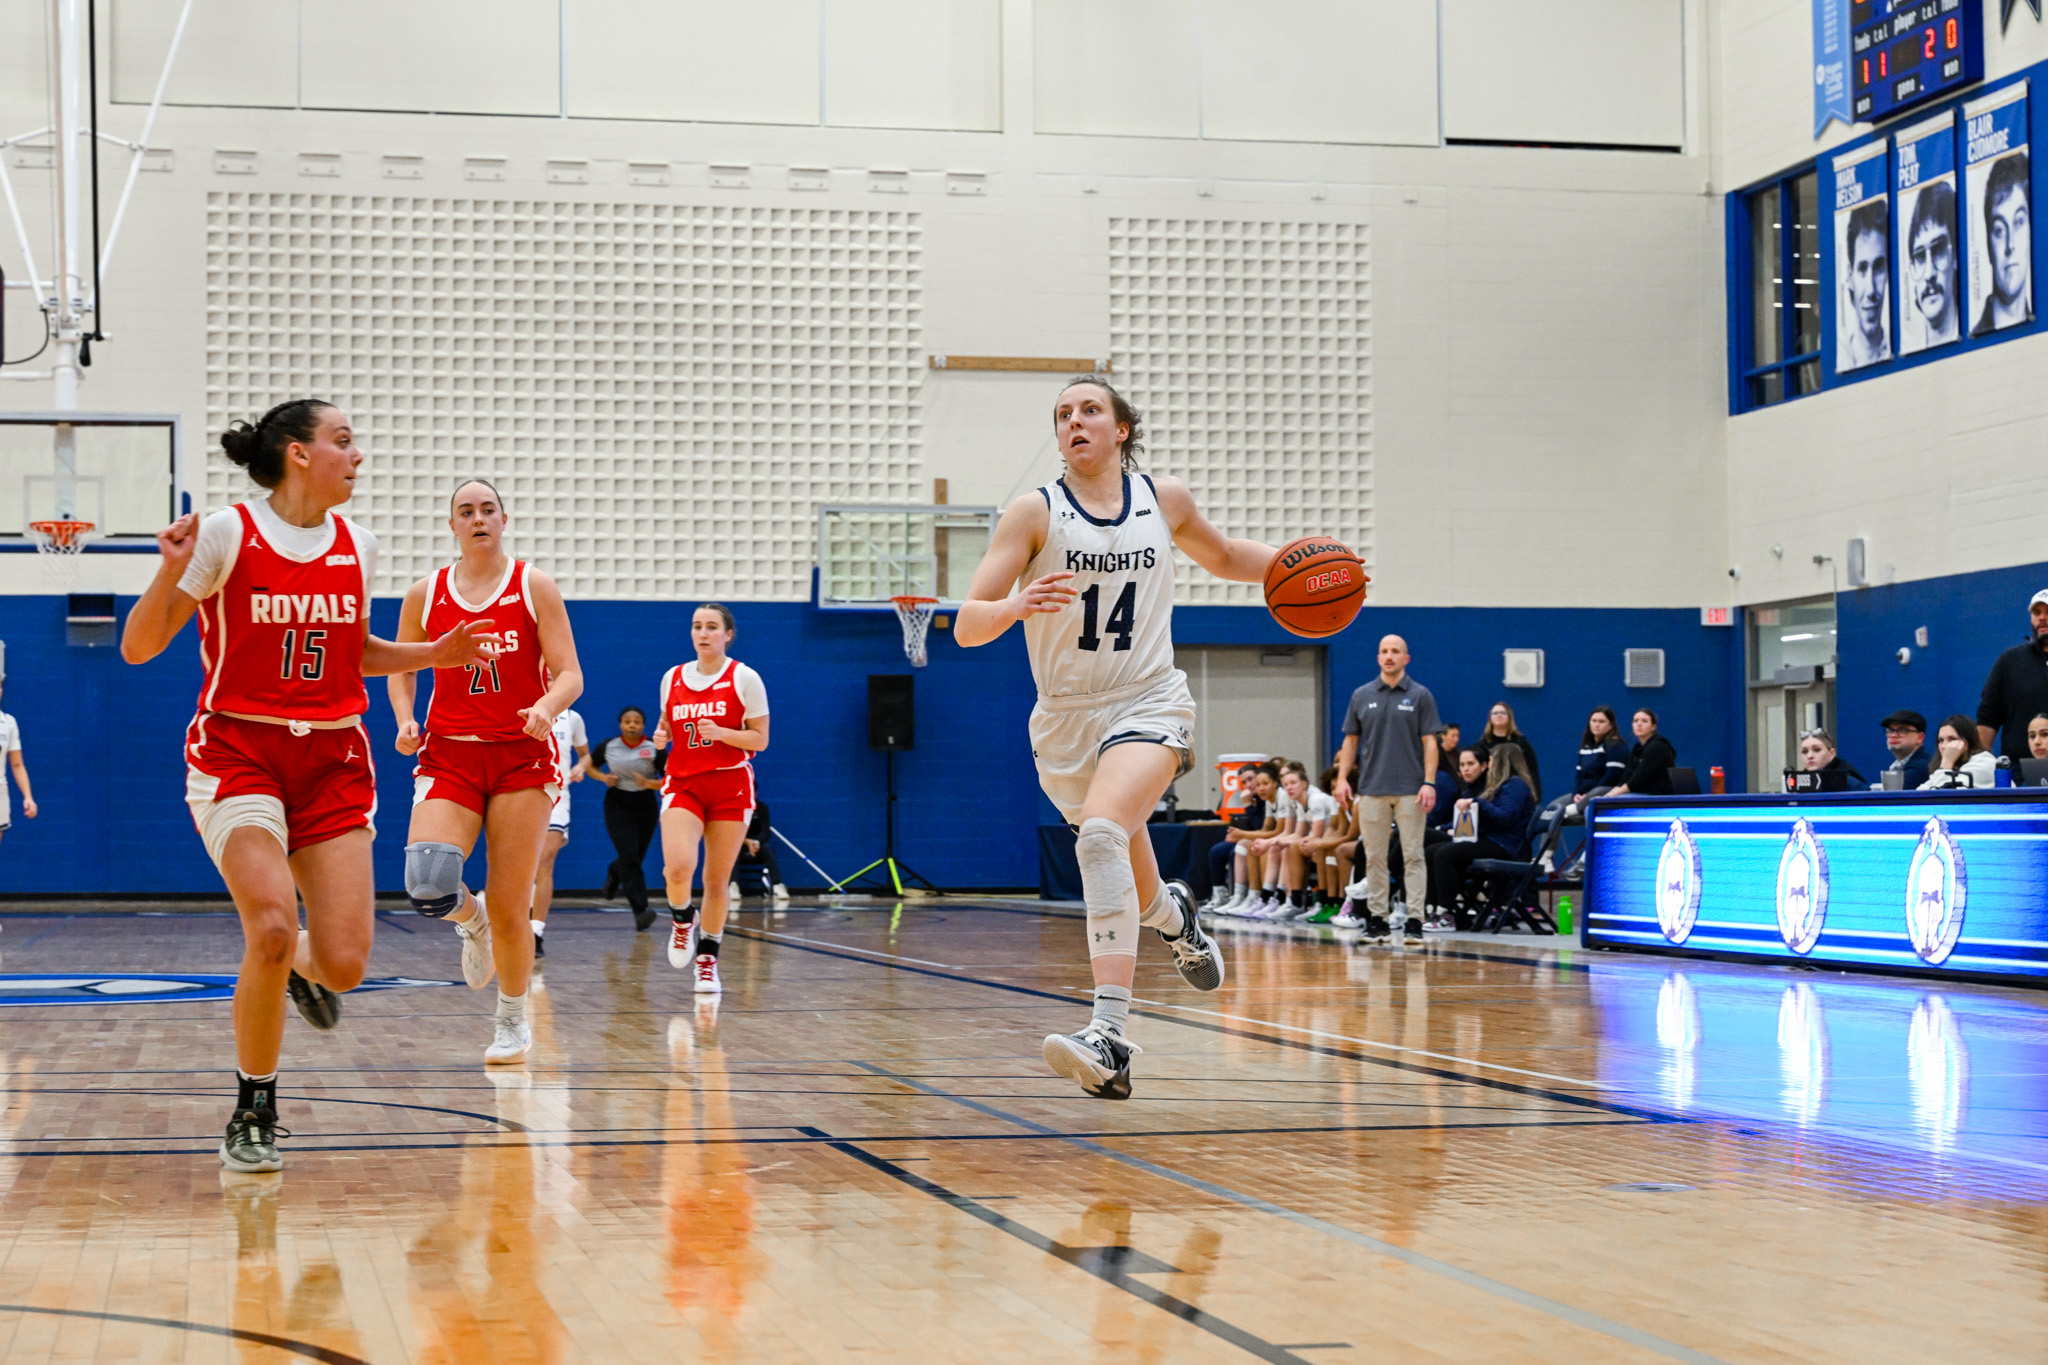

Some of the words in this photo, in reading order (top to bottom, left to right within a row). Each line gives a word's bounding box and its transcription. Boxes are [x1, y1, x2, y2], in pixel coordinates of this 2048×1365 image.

[1967, 113, 1993, 142] BLAIR
[1898, 163, 1920, 188] PEAT
[1065, 546, 1156, 574] KNIGHTS
[1281, 543, 1349, 570] Wilson
[1306, 567, 1351, 592] OCAA
[250, 593, 357, 624] ROYALS
[1078, 581, 1137, 652] 14
[1707, 607, 1728, 624] EXIT
[280, 628, 328, 681] 15
[463, 658, 501, 695] 21
[672, 700, 727, 722] ROYALS
[1222, 770, 1239, 792] G
